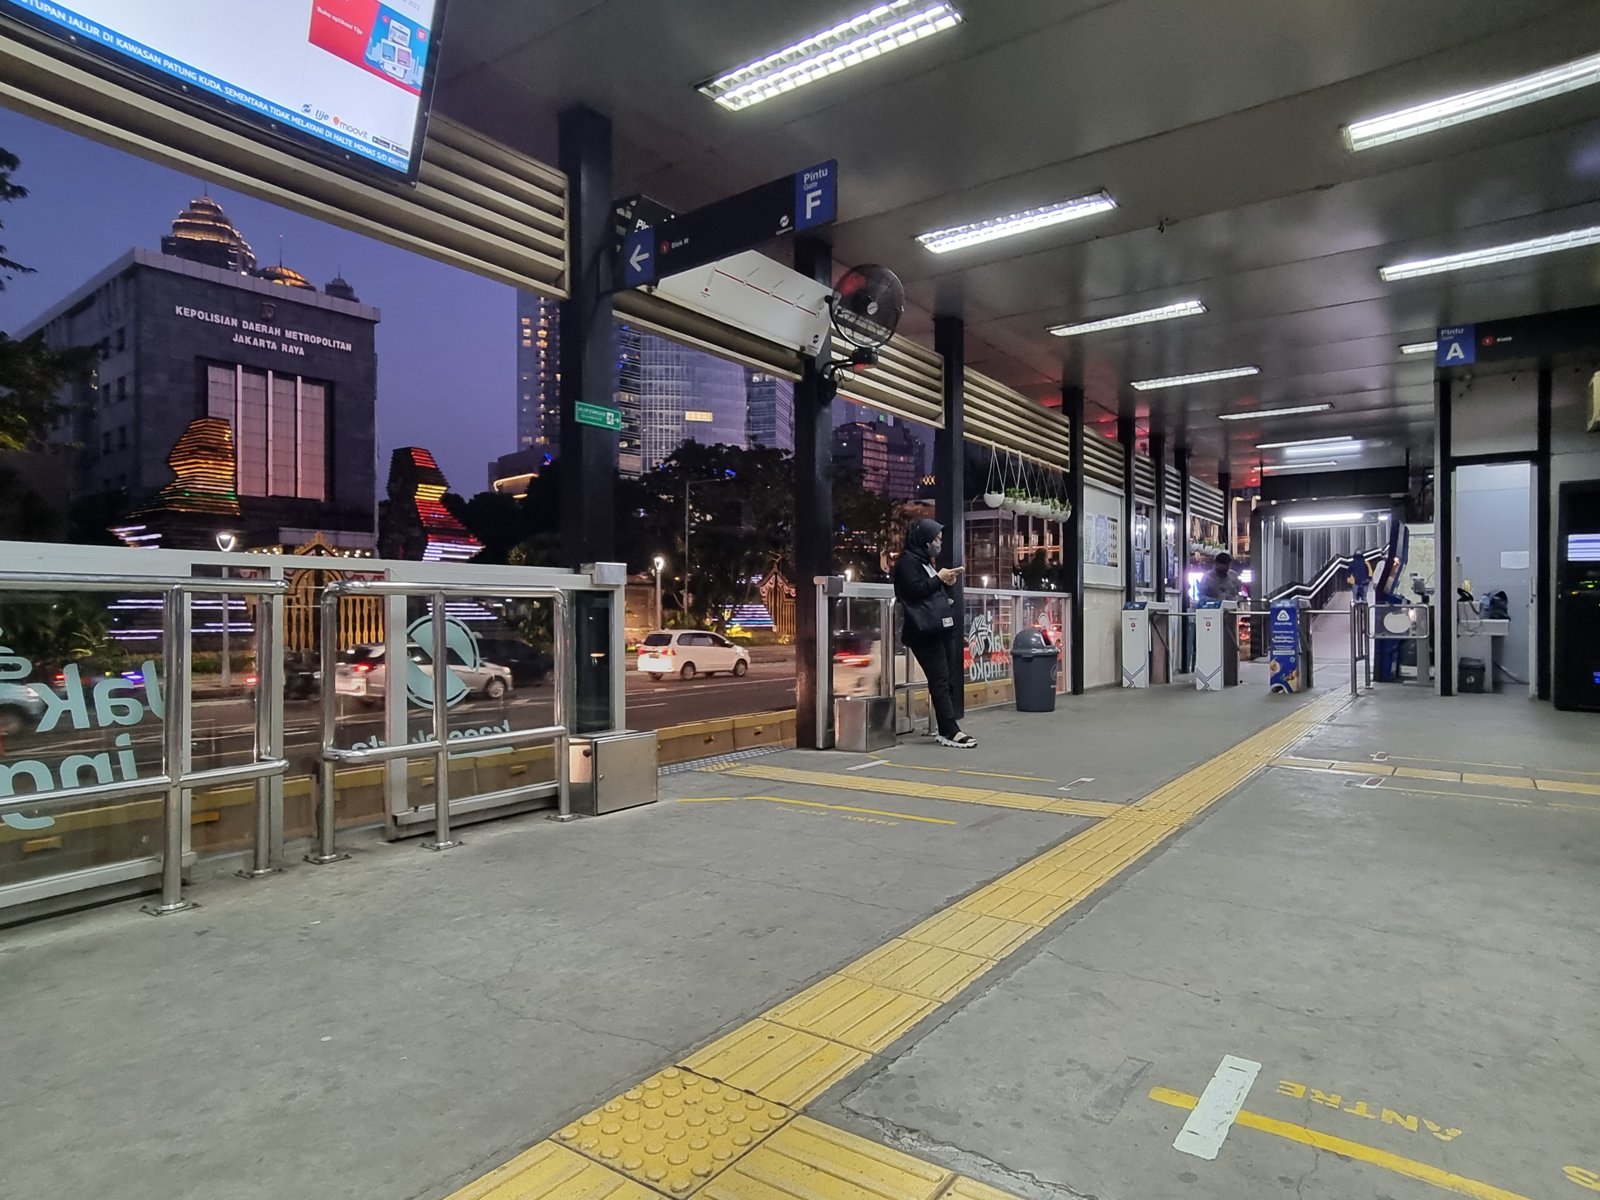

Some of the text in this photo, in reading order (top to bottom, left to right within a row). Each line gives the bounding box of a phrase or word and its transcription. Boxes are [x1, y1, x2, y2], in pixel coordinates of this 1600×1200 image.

[68, 15, 100, 38] JALUR
[102, 32, 114, 44] DI
[115, 37, 161, 66] KAWASAN
[163, 59, 198, 81] PATUNG
[224, 86, 270, 113] SEMENTARA
[269, 105, 291, 122] TIDAK
[291, 115, 324, 137] MELAYANI
[324, 129, 333, 139] DI
[333, 132, 354, 148] HALTE
[353, 141, 377, 157] MONAS
[340, 121, 368, 139] moovit
[803, 167, 829, 184] Pintu
[805, 189, 823, 220] F
[175, 305, 352, 352] KEPOLISIAN DAERAH METROPOLITAN
[1441, 328, 1464, 336] Pintu
[232, 333, 305, 356] JAKARTA RAYA
[1445, 342, 1465, 360] A
[1276, 1079, 1463, 1142] ANTRE
